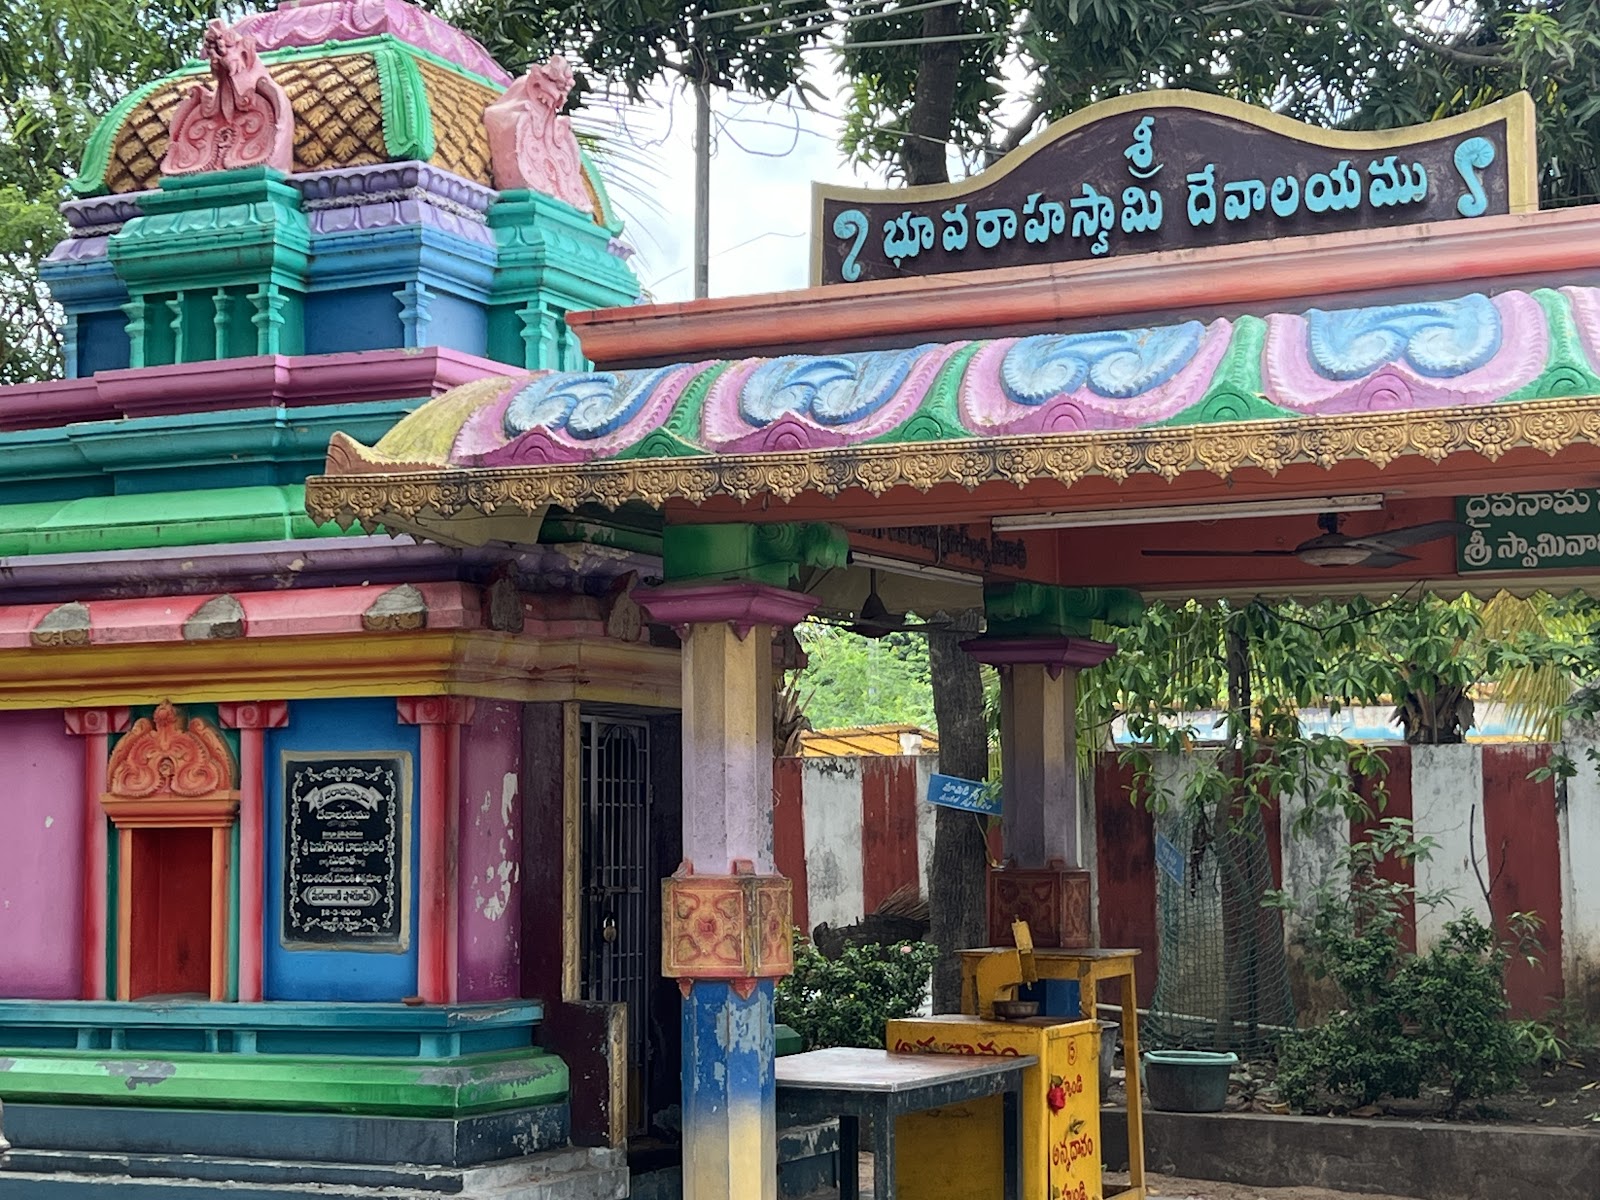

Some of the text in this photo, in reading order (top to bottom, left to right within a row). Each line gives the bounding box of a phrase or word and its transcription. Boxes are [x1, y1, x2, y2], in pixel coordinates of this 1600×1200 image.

[1124, 115, 1164, 179] శ్రీ
[883, 156, 1429, 258] భూవరాహస్వామి దేవాలయము
[1464, 530, 1600, 567] శ్రీ స్వామివా
[1053, 1134, 1093, 1173] అన్నదానం
